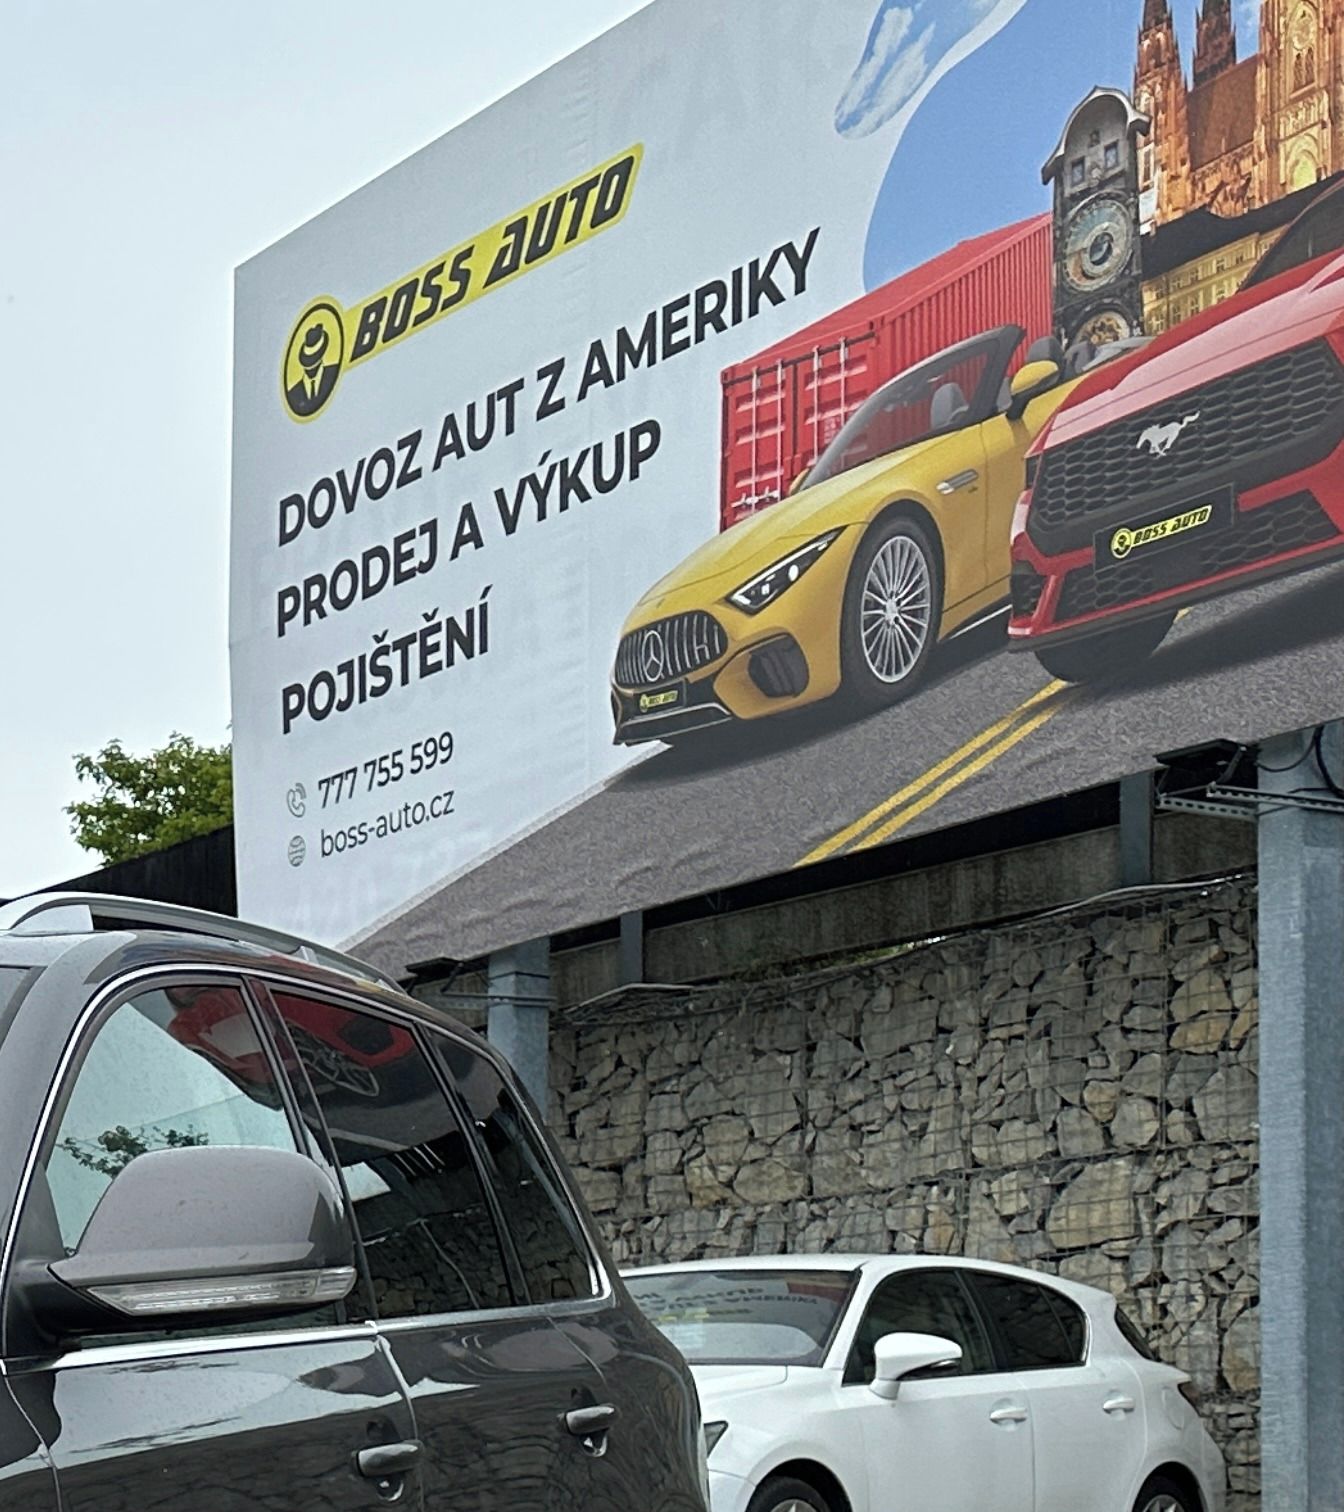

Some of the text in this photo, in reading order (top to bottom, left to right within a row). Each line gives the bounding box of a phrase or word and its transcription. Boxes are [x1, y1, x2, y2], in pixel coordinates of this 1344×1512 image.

[349, 155, 636, 363] BOSS AUTO
[278, 226, 821, 547] DOVOZ AUT Z AMERIKY
[277, 419, 662, 638] PRODEJ A VÝKUP
[1133, 508, 1209, 545] BOSS AUTO
[281, 583, 494, 735] POJIŠTĚNÍ
[317, 731, 454, 809] 777 755 599
[320, 790, 455, 858] boss-auto.cz
